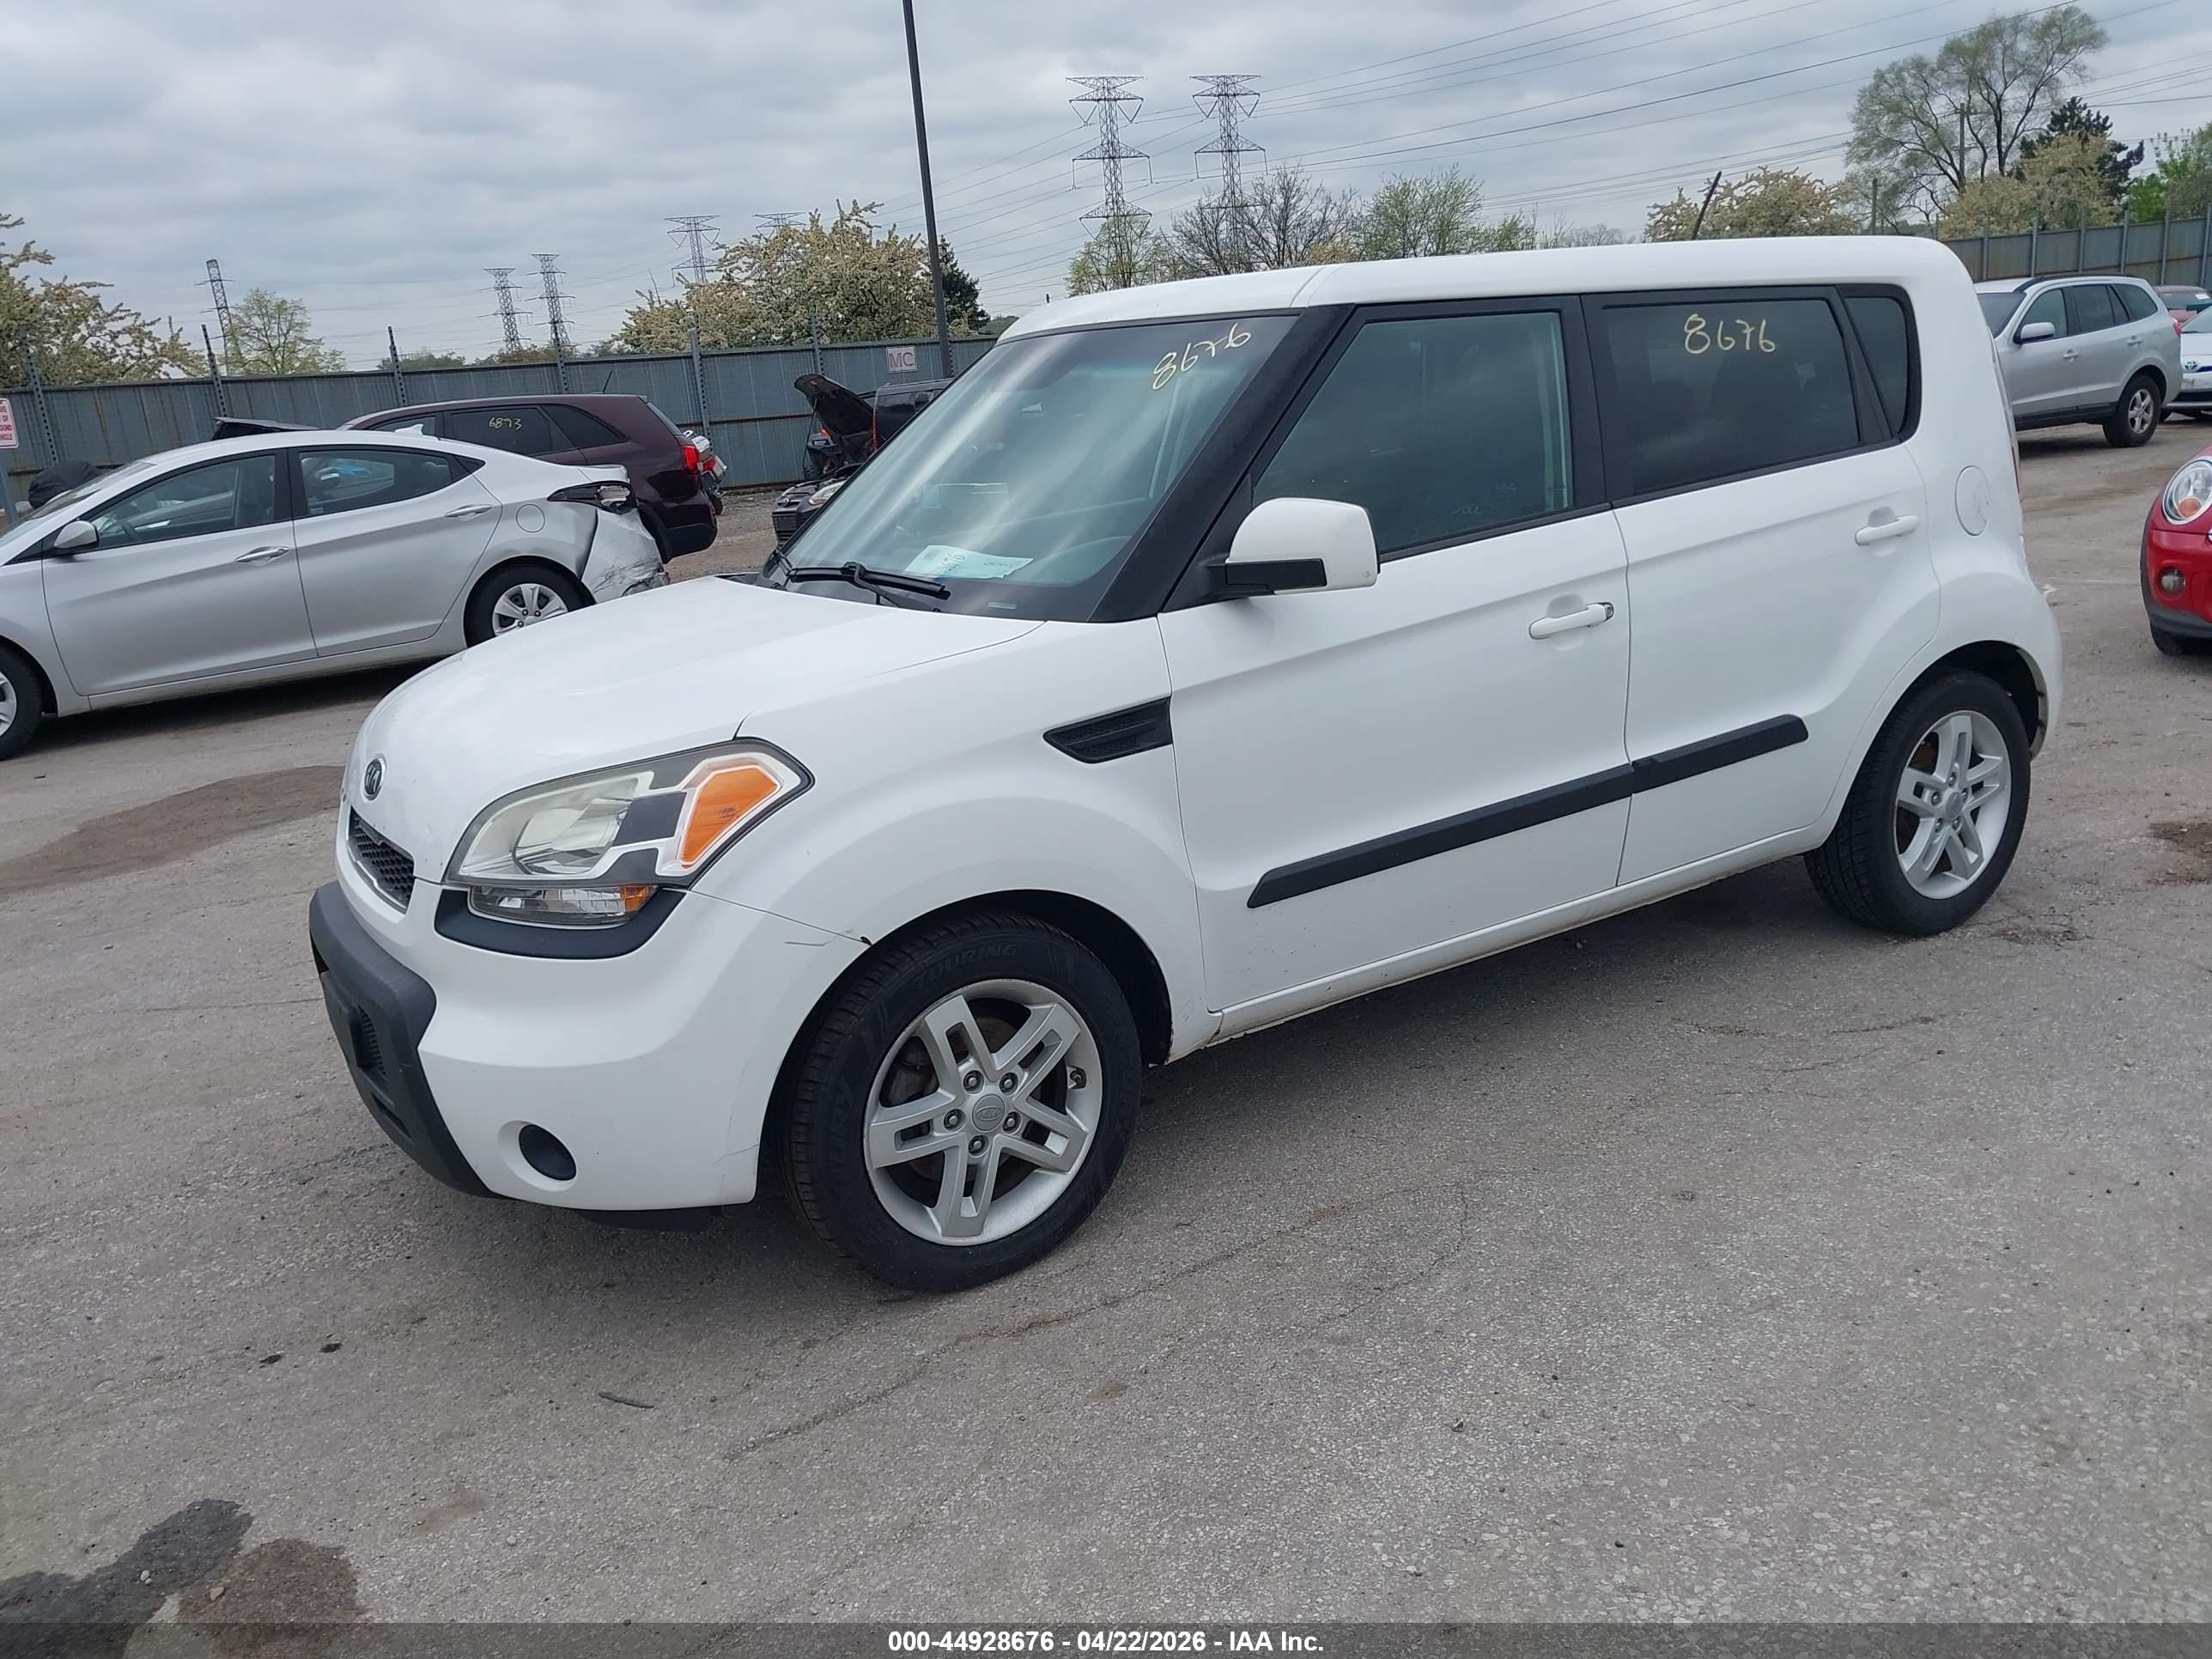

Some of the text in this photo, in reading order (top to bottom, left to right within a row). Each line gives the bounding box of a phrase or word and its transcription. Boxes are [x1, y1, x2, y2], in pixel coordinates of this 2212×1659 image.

[1684, 313, 1776, 355] 8676
[889, 352, 915, 368] MC
[1152, 322, 1252, 391] 8676
